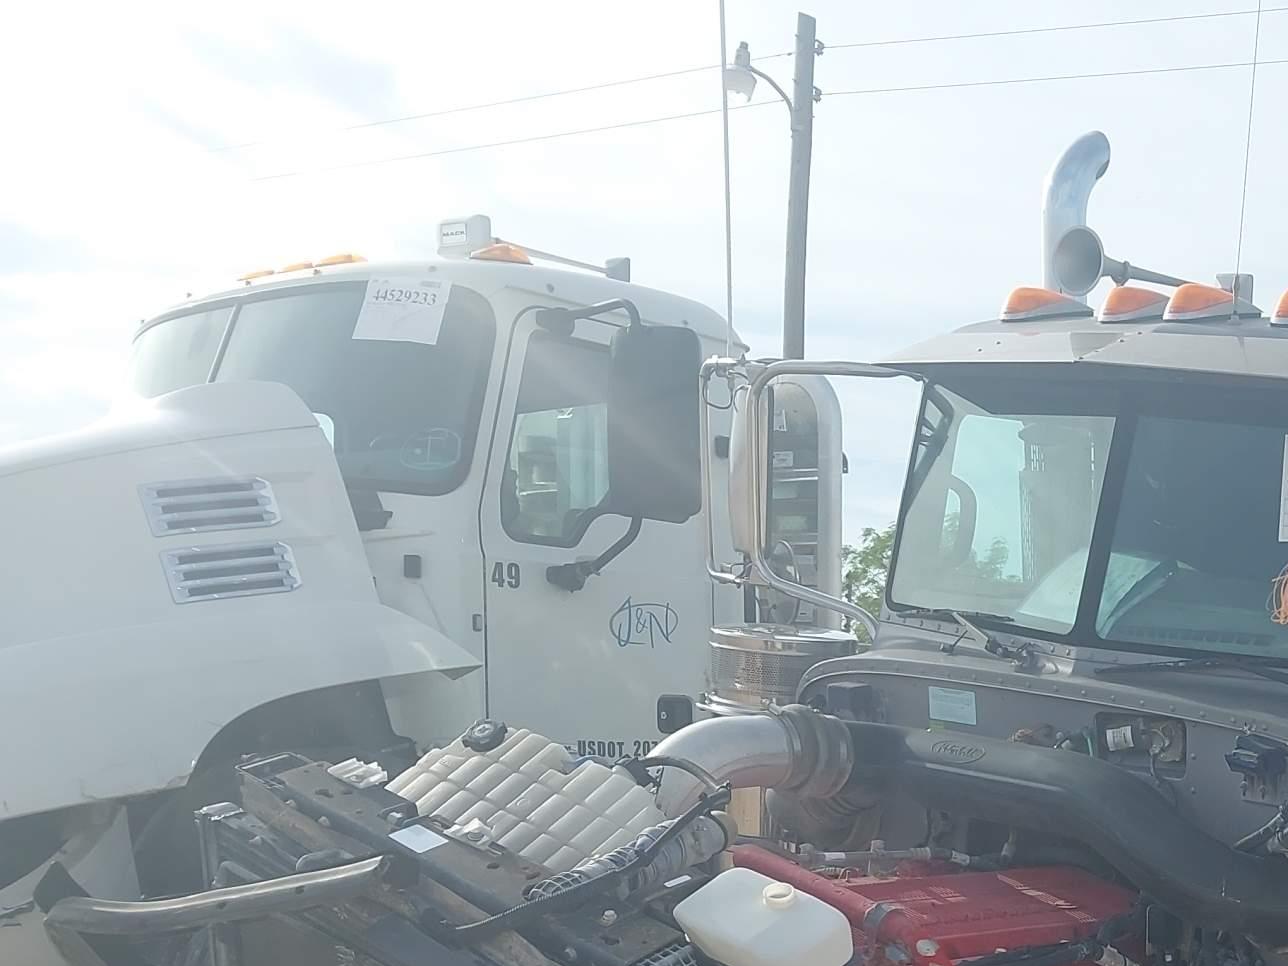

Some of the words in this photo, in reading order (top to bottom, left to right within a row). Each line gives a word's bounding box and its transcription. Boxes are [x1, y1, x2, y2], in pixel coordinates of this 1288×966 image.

[373, 287, 437, 305] 44529233
[491, 562, 520, 589] 49
[616, 596, 672, 648] J&N
[577, 740, 625, 758] USDOT
